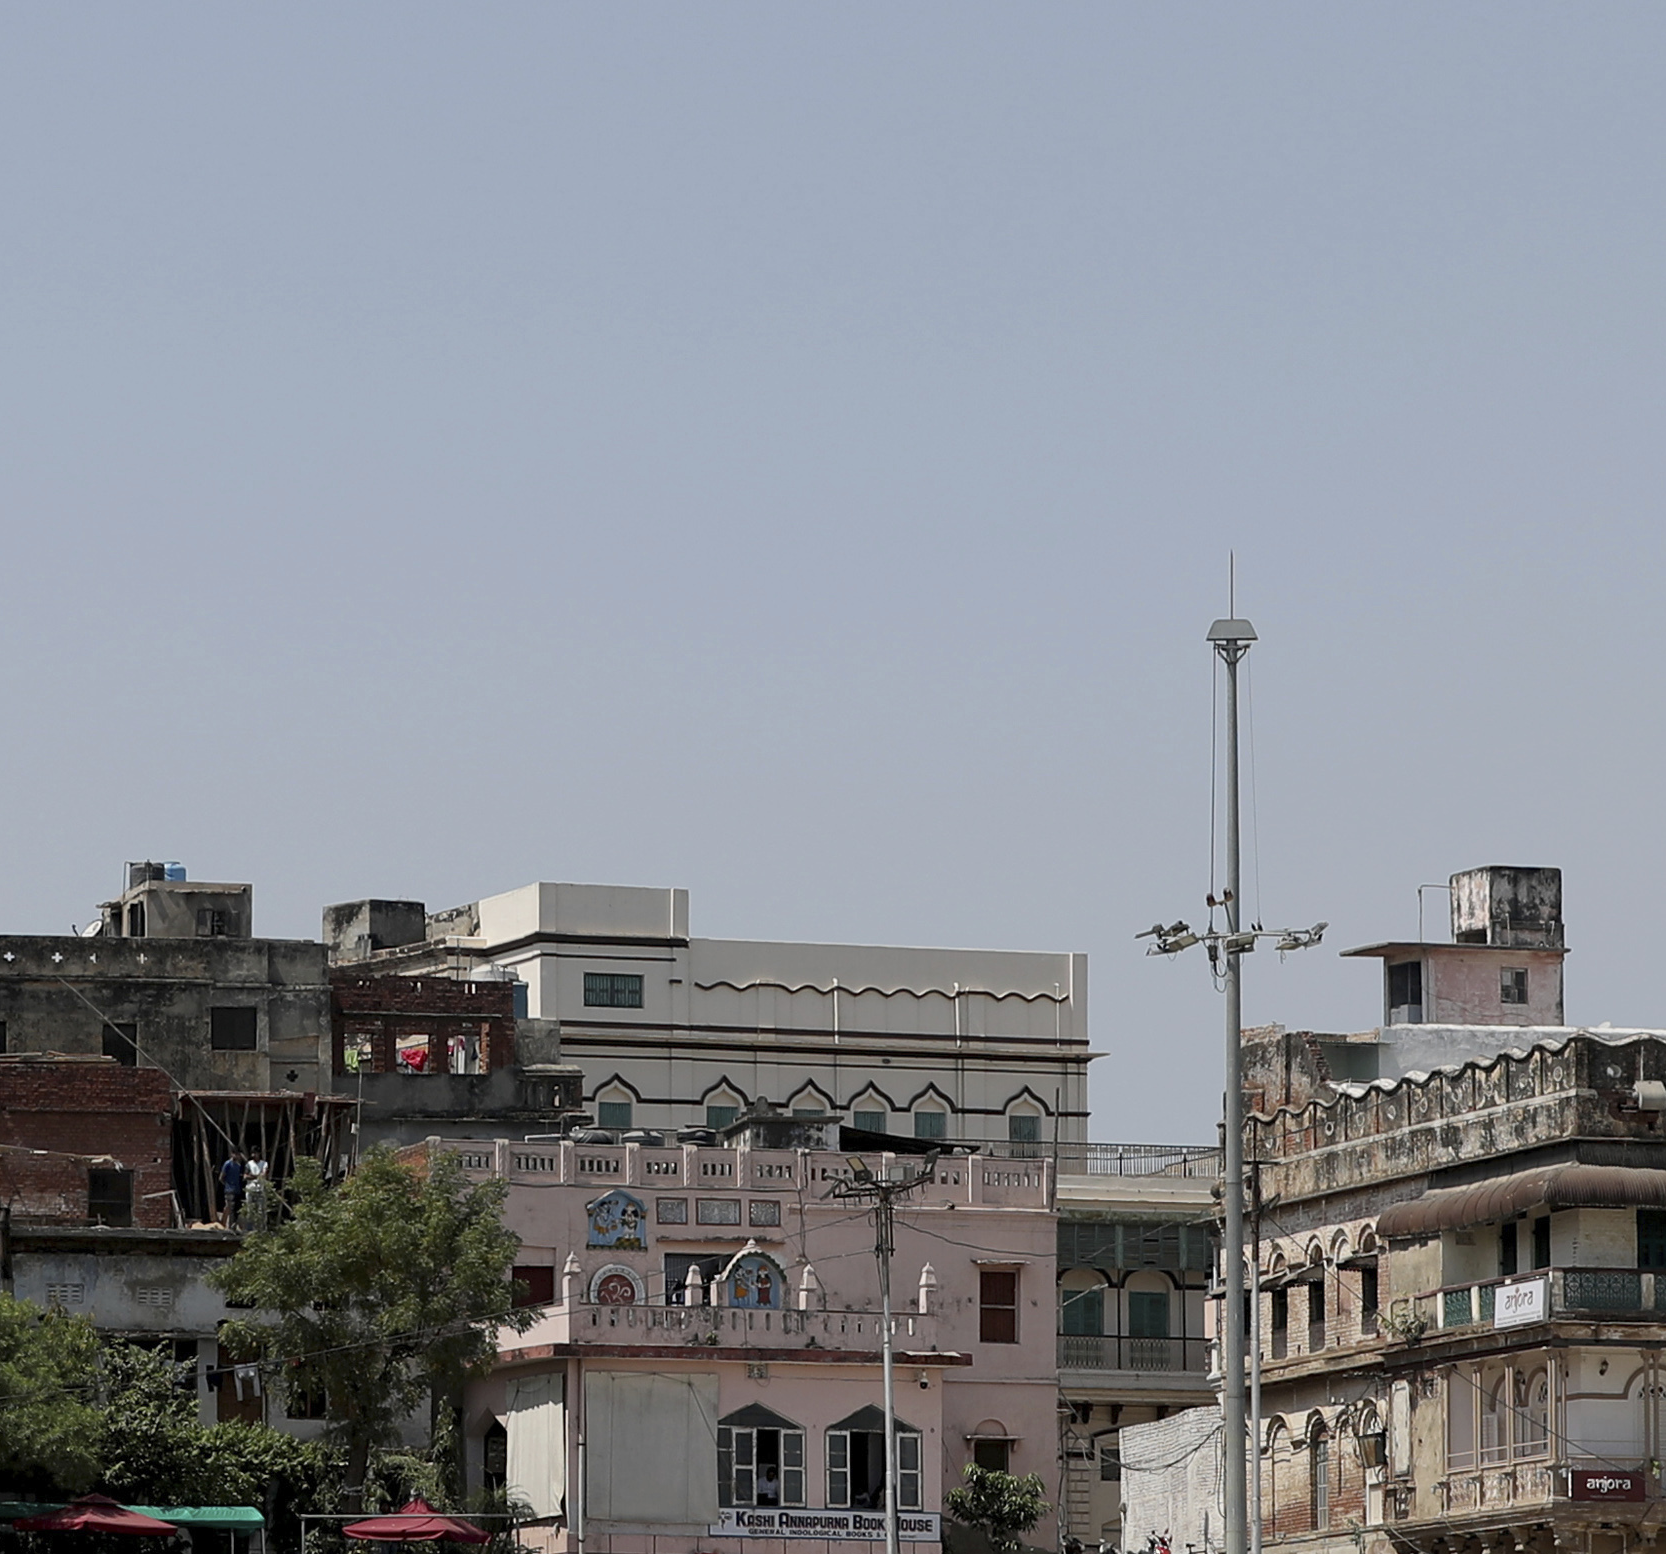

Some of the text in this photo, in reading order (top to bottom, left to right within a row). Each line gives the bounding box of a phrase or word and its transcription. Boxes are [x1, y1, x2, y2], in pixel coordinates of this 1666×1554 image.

[1586, 1476, 1632, 1493] anjora
[748, 1528, 786, 1536] GENERAL
[789, 1529, 842, 1537] INDOLOGICAL
